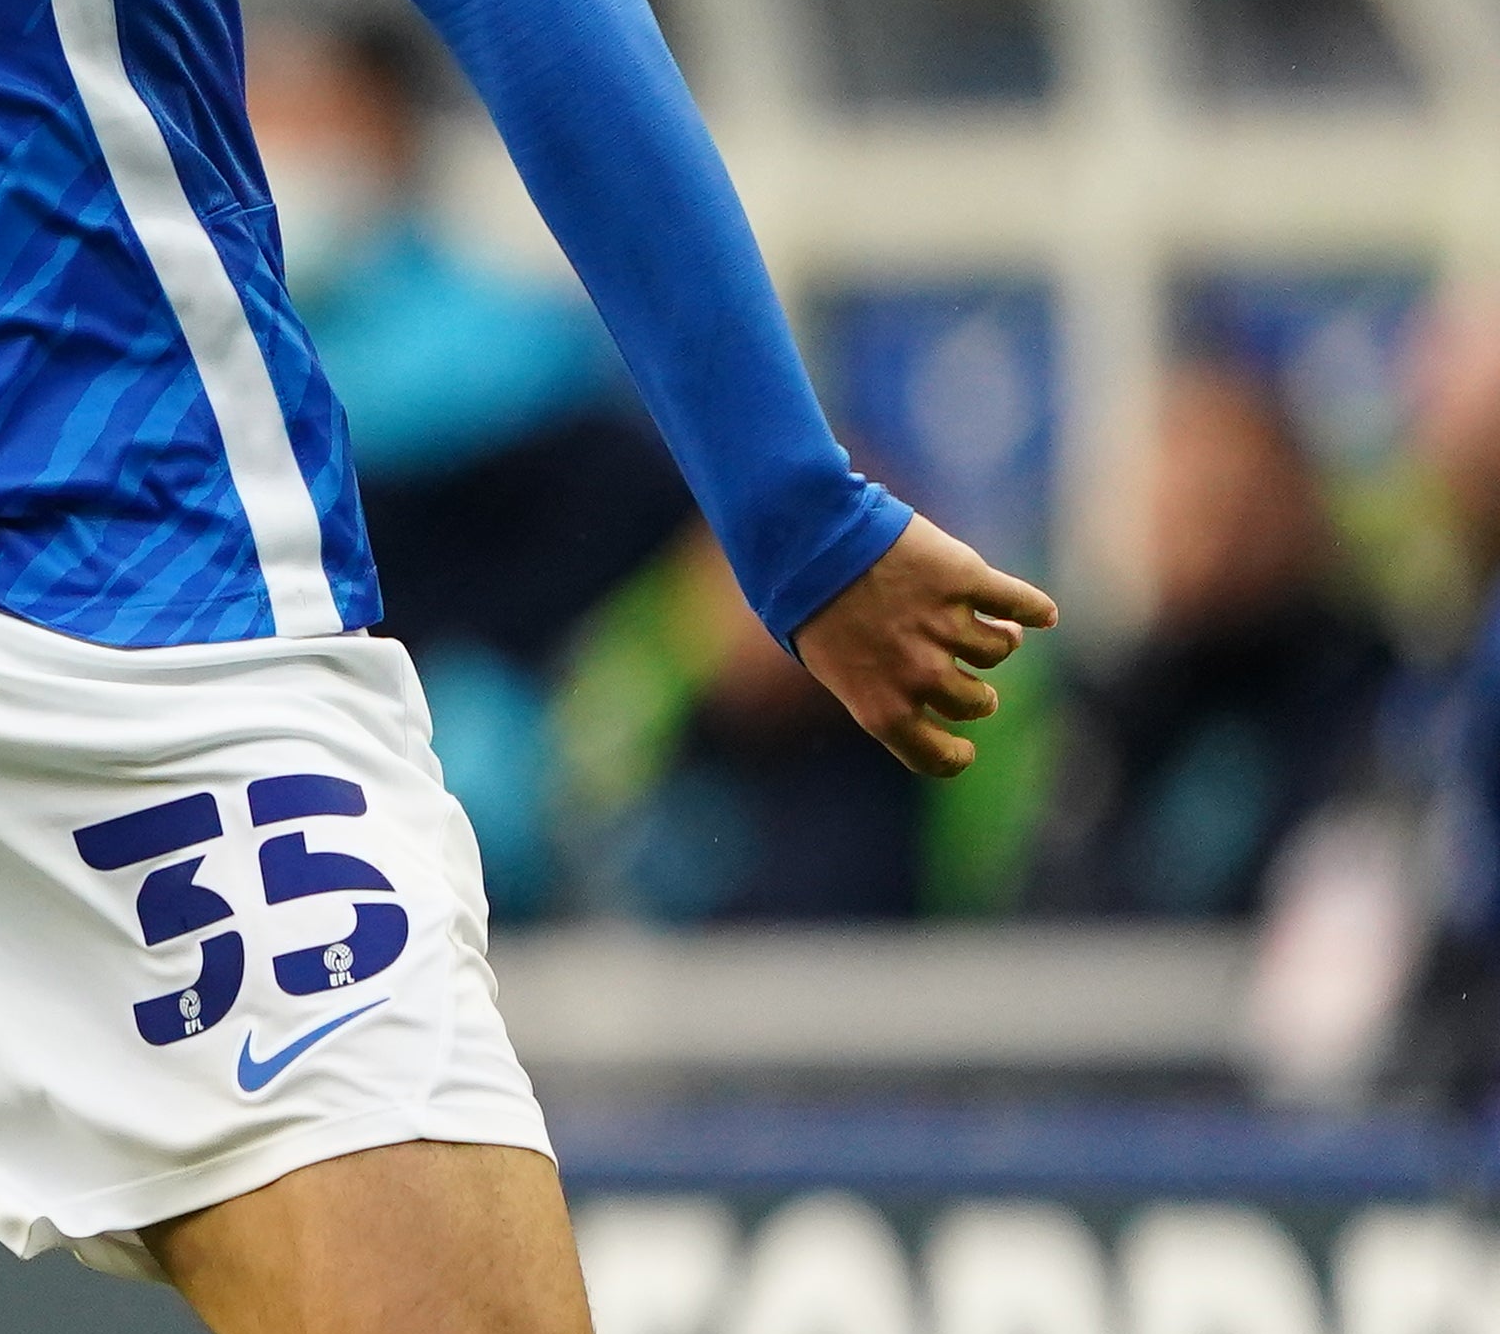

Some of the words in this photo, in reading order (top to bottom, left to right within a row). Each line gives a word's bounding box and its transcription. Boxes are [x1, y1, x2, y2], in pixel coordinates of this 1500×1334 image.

[72, 774, 409, 1046] 35
[328, 969, 356, 988] EFL
[184, 1018, 205, 1036] EFL
